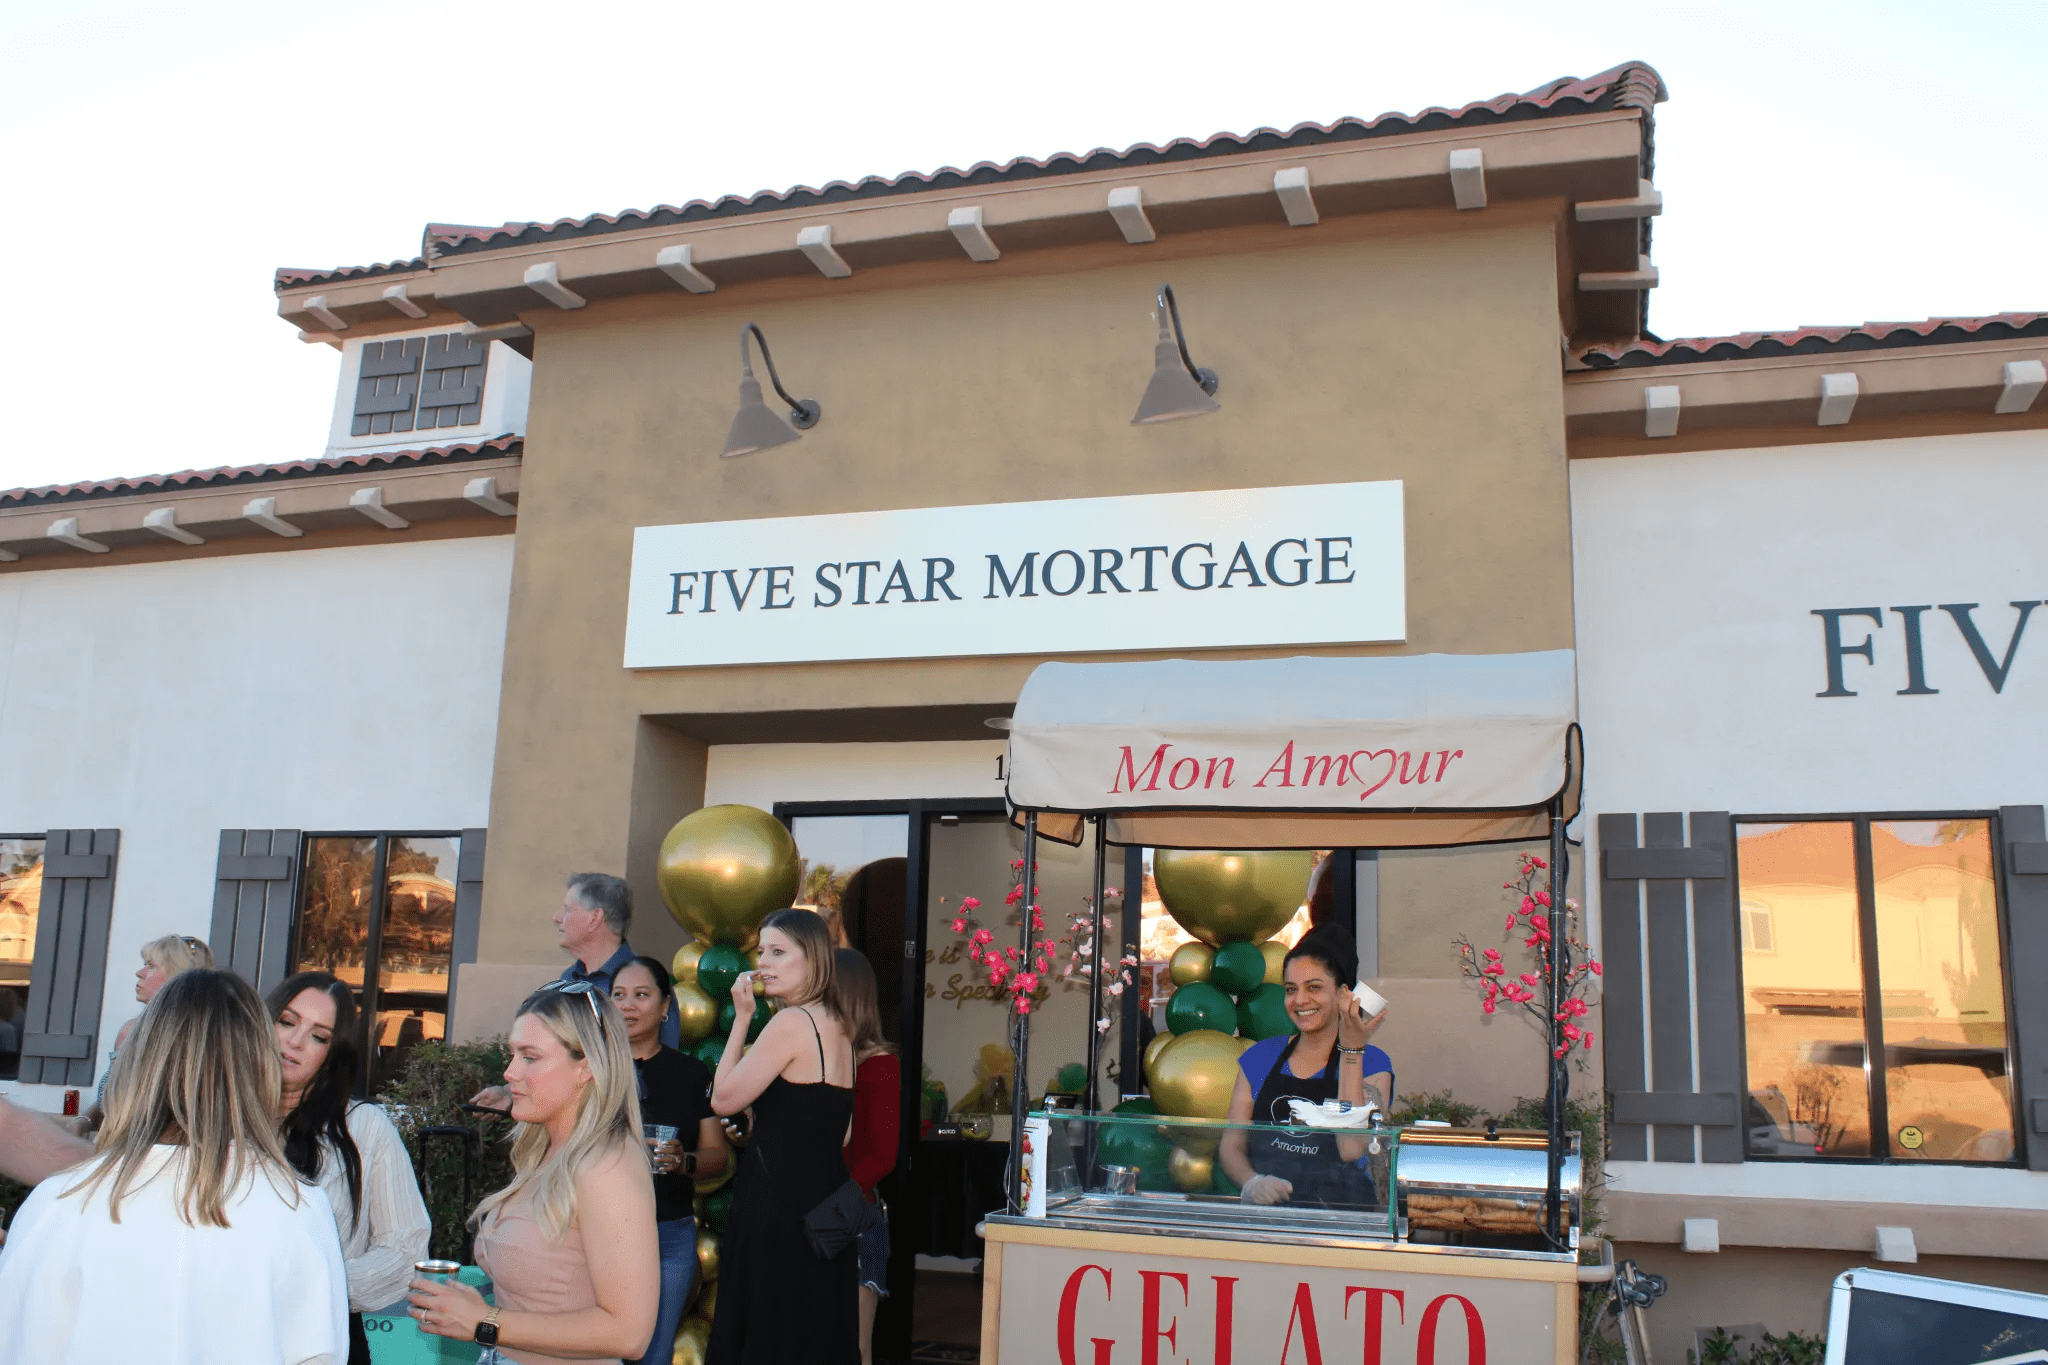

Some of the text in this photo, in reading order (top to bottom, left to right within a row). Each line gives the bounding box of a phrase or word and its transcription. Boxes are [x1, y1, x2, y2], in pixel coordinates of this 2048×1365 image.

[666, 536, 1356, 615] FIVE STAR MORTGAGE
[1810, 599, 2048, 697] FIV
[1107, 743, 1235, 794] Mon
[1270, 1137, 1320, 1155] Amorino
